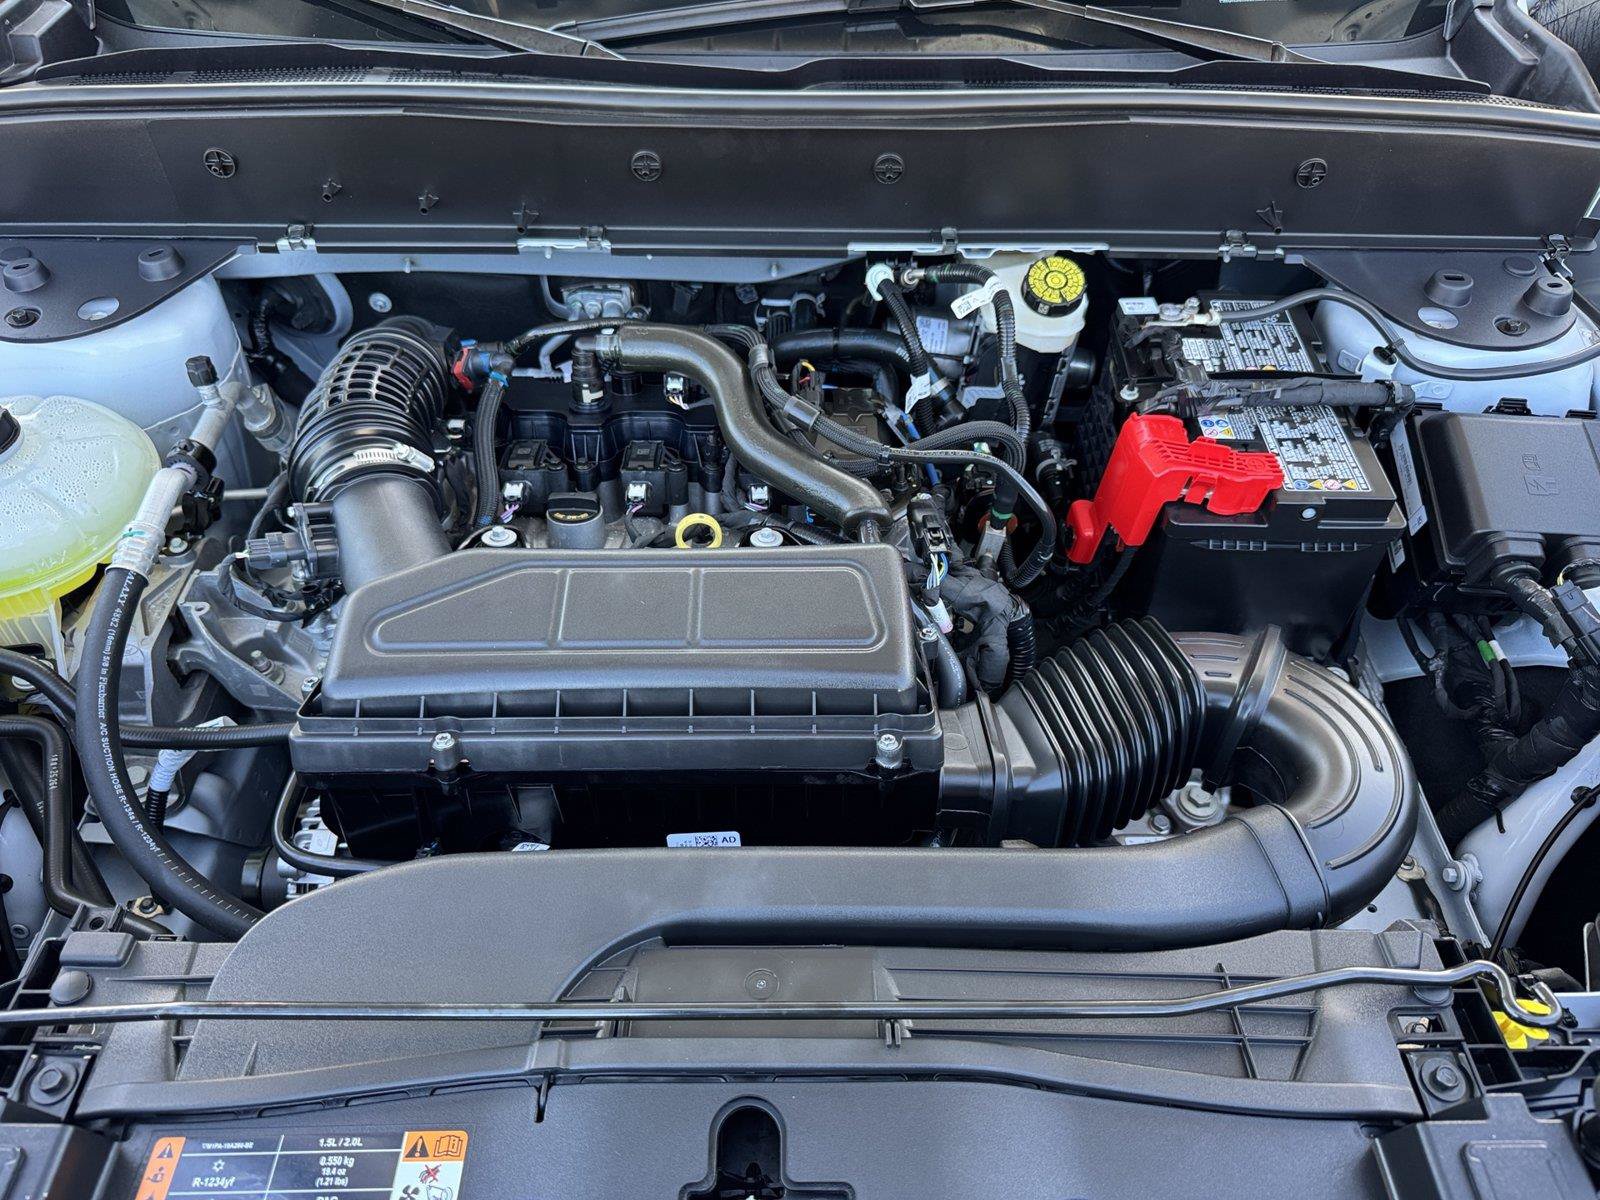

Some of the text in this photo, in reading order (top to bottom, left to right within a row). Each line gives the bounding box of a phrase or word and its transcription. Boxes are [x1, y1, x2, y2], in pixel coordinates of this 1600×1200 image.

[103, 628, 116, 654] (16mm)
[102, 655, 111, 667] 5/8
[100, 722, 108, 736] A/C
[101, 737, 116, 772] SUCTION
[109, 771, 124, 795] HOSE
[118, 794, 136, 821] R-134a
[319, 1137, 337, 1148] 1.5L
[343, 1137, 363, 1147] 2.0L
[319, 1155, 355, 1168] 0.550 kg
[321, 1167, 347, 1176] 19.4 oz
[192, 1176, 236, 1189] R-1234yf
[314, 1176, 349, 1188] (1.21 lbs)
